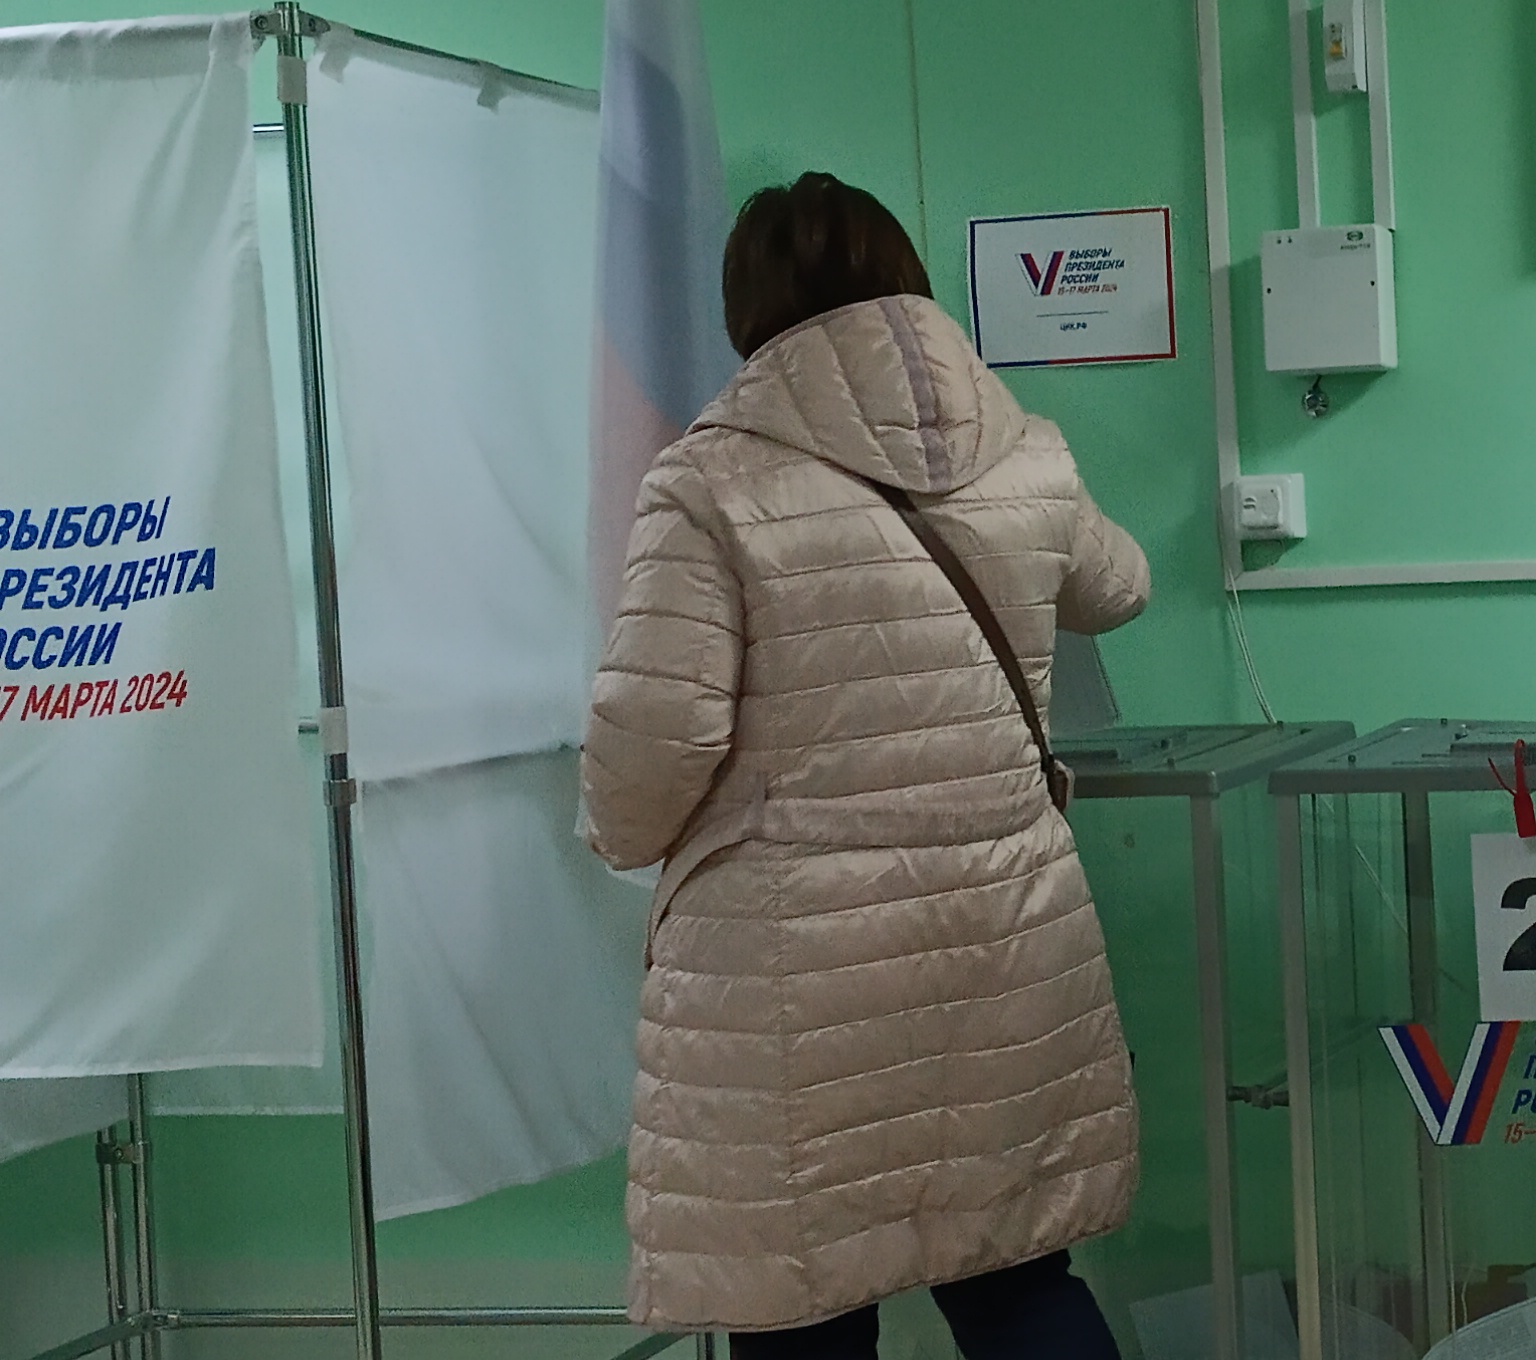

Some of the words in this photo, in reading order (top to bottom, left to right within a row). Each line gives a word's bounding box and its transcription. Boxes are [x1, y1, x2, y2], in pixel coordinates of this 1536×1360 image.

[1064, 259, 1125, 272] ПРЕЗИДЕНТА
[1069, 246, 1113, 260] ВЫБОРЫ
[1060, 273, 1099, 285] РОССИИ
[0, 547, 216, 612] РЕЗИДЕНТА
[0, 622, 122, 671] ССИИ
[20, 678, 119, 722] МАРТА
[119, 669, 188, 715] 2024
